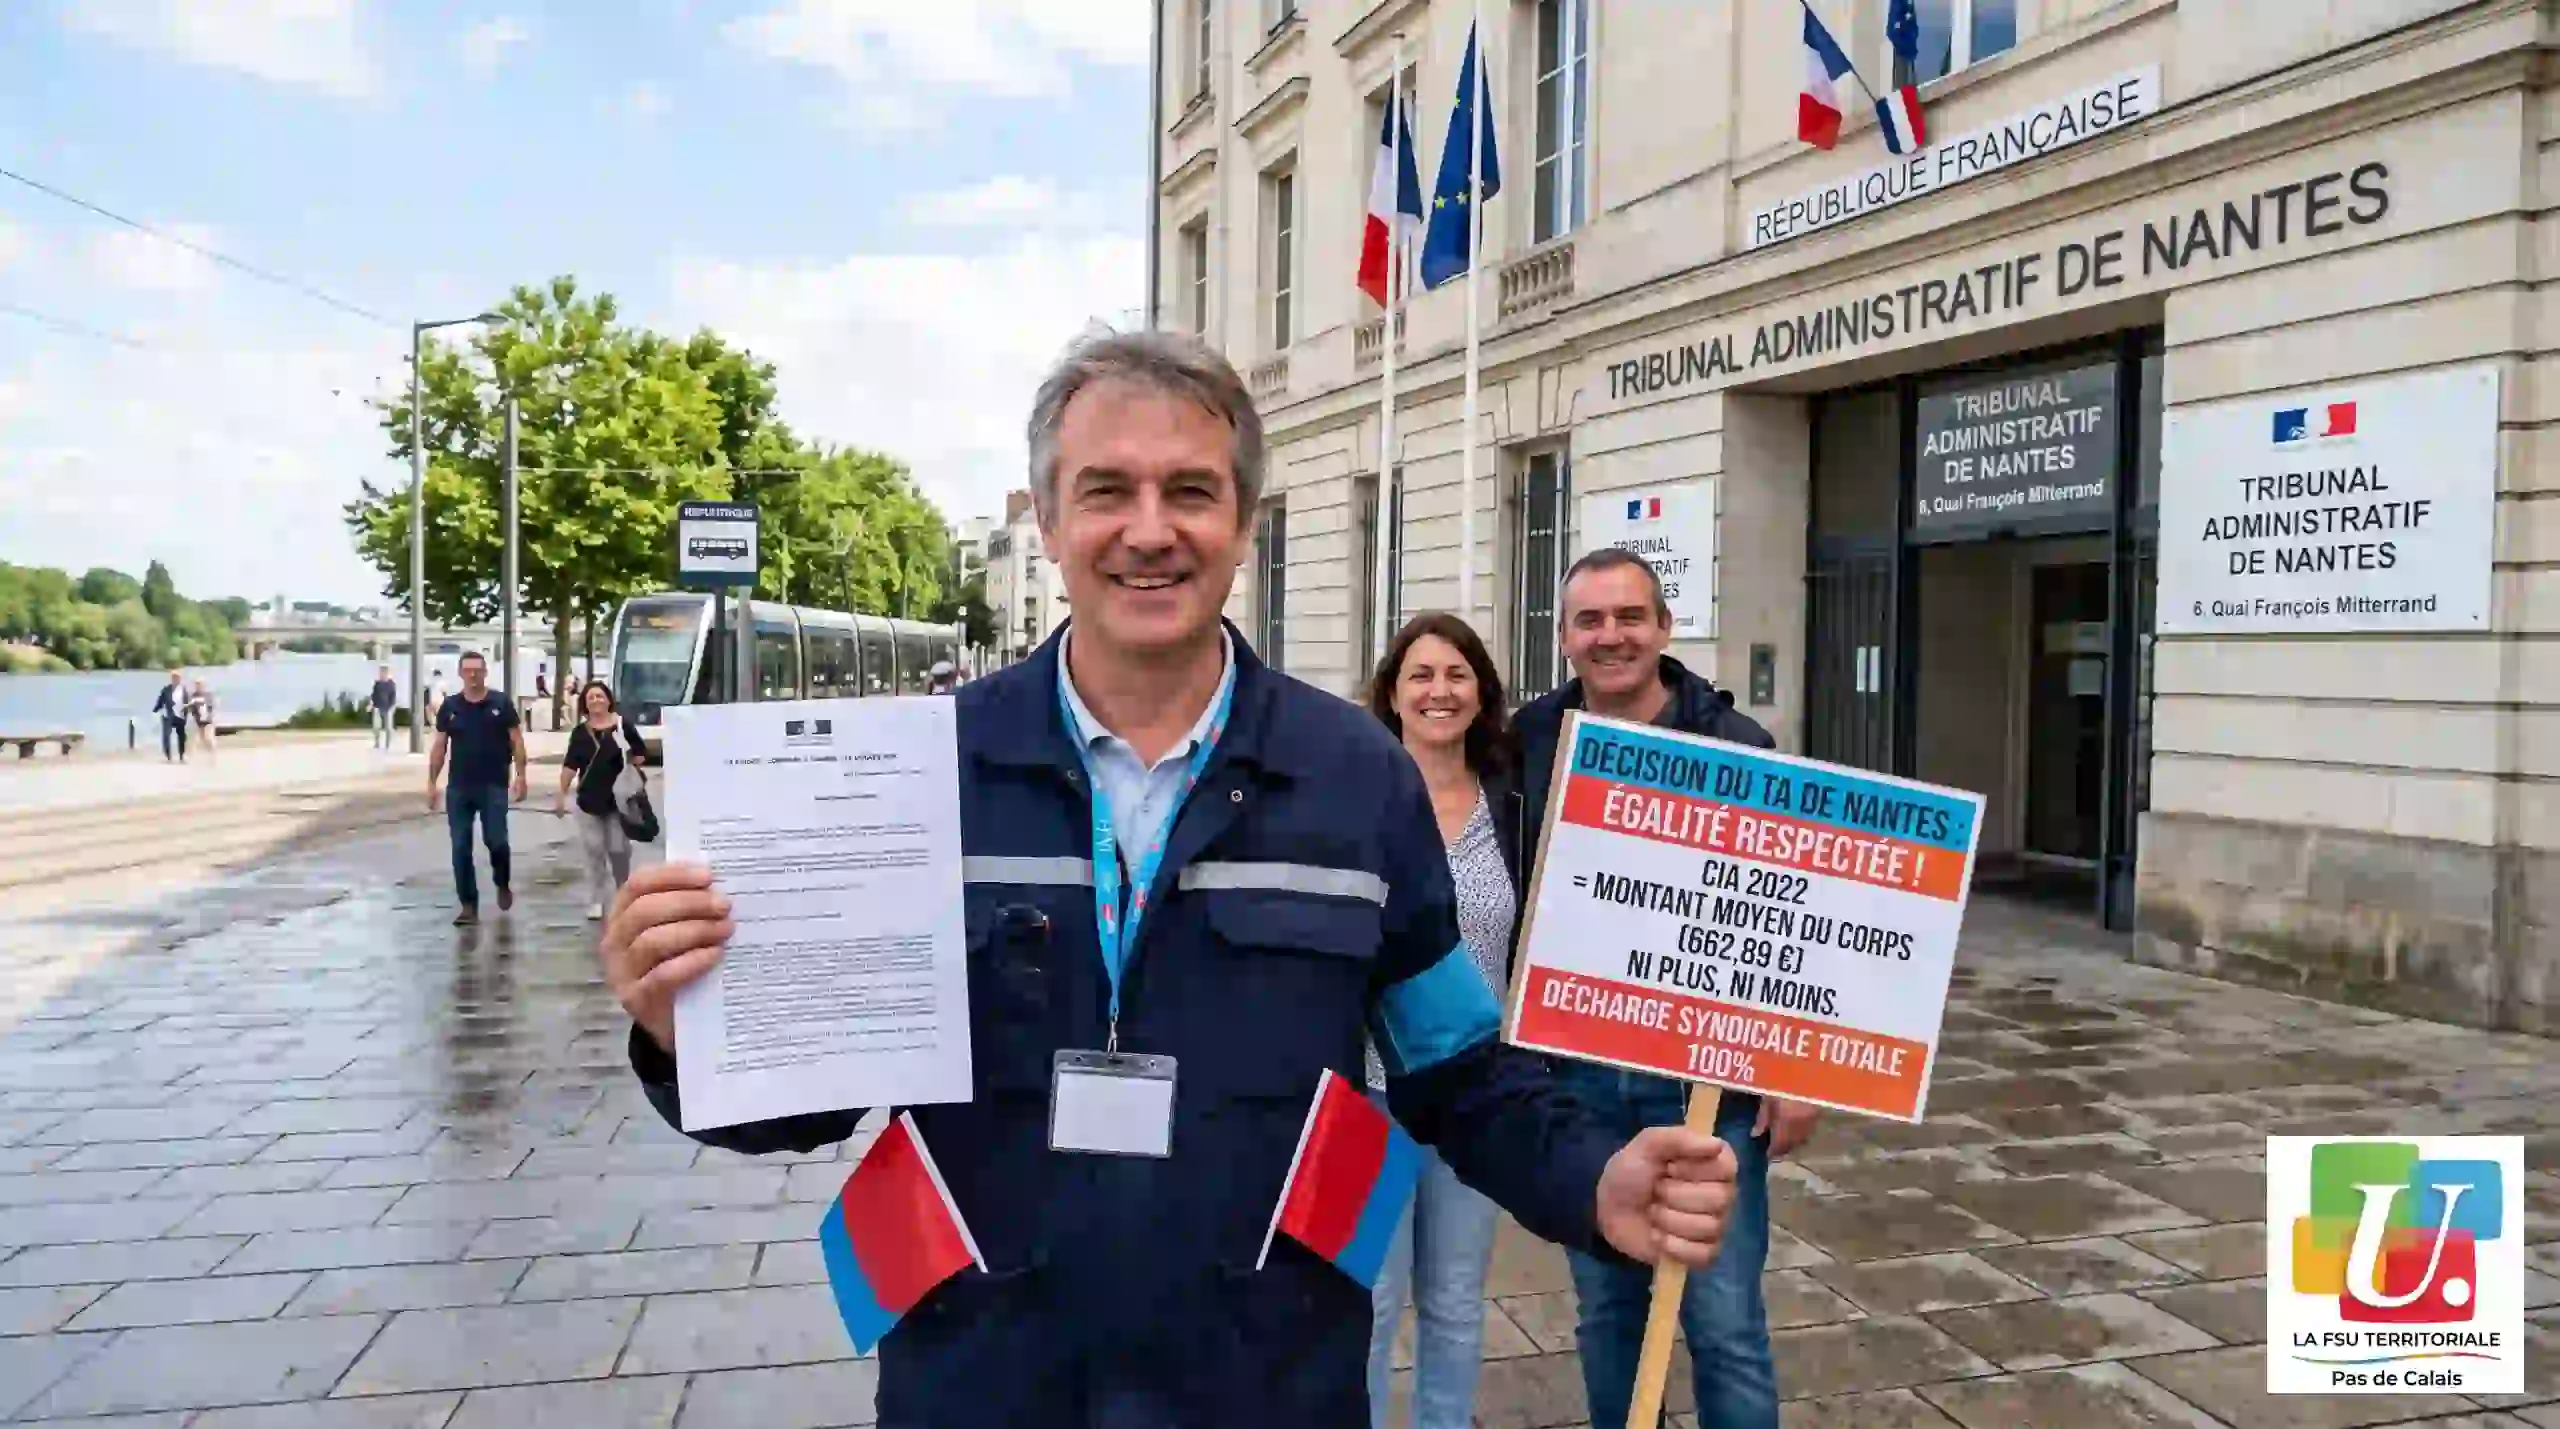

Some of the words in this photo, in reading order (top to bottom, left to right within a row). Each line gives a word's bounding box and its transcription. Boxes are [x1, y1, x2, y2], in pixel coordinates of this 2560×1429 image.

[1756, 156, 1928, 245] RÉPUBLIQUE
[1938, 79, 2141, 185] FRANÇAISE
[1606, 333, 1743, 399] TRIBUNAL
[1751, 253, 2041, 368] ADMINISTRATIF
[2058, 230, 2125, 297] DE
[2143, 162, 2389, 276] NANTES
[1955, 381, 2072, 421] TRIBUNAL
[1923, 407, 2102, 456] ADMINISTRATIF
[1944, 458, 1974, 484] DE
[1980, 444, 2076, 480] NANTES
[2240, 465, 2389, 503] TRIBUNAL
[2202, 500, 2432, 541] ADMINISTRATIF
[2229, 549, 2266, 576] DE
[2275, 542, 2397, 574] NANTES
[2211, 598, 2250, 618] Quai
[2254, 596, 2330, 620] François
[2336, 594, 2437, 613] Mitterrand
[1580, 733, 1709, 793] DÉCISION
[1714, 764, 1753, 800] DU
[1763, 773, 1791, 810] TA
[1800, 781, 1837, 819] DE
[1842, 791, 1950, 841] NANTES
[1603, 783, 1732, 848] ÉGALITÉ
[1735, 813, 1909, 885] RESPECTÉE
[1911, 851, 1925, 887] !
[1702, 859, 1740, 892] CIA
[1746, 868, 1808, 905] 2022
[1592, 871, 1708, 920] MONTANT
[1712, 896, 1796, 938] MOYEN
[1800, 914, 1832, 945] DU
[1838, 921, 1914, 961] CORPS
[1627, 949, 1653, 979] NI
[1657, 955, 1720, 997] PLUS,
[1729, 970, 1755, 1000] NI
[1760, 976, 1840, 1017] MOINS.
[1542, 977, 1674, 1031] DÉCHARGE
[1677, 1005, 1814, 1057] SYNDICALE
[1818, 1033, 1908, 1077] TOTALE
[1687, 1043, 1755, 1083] 100%
